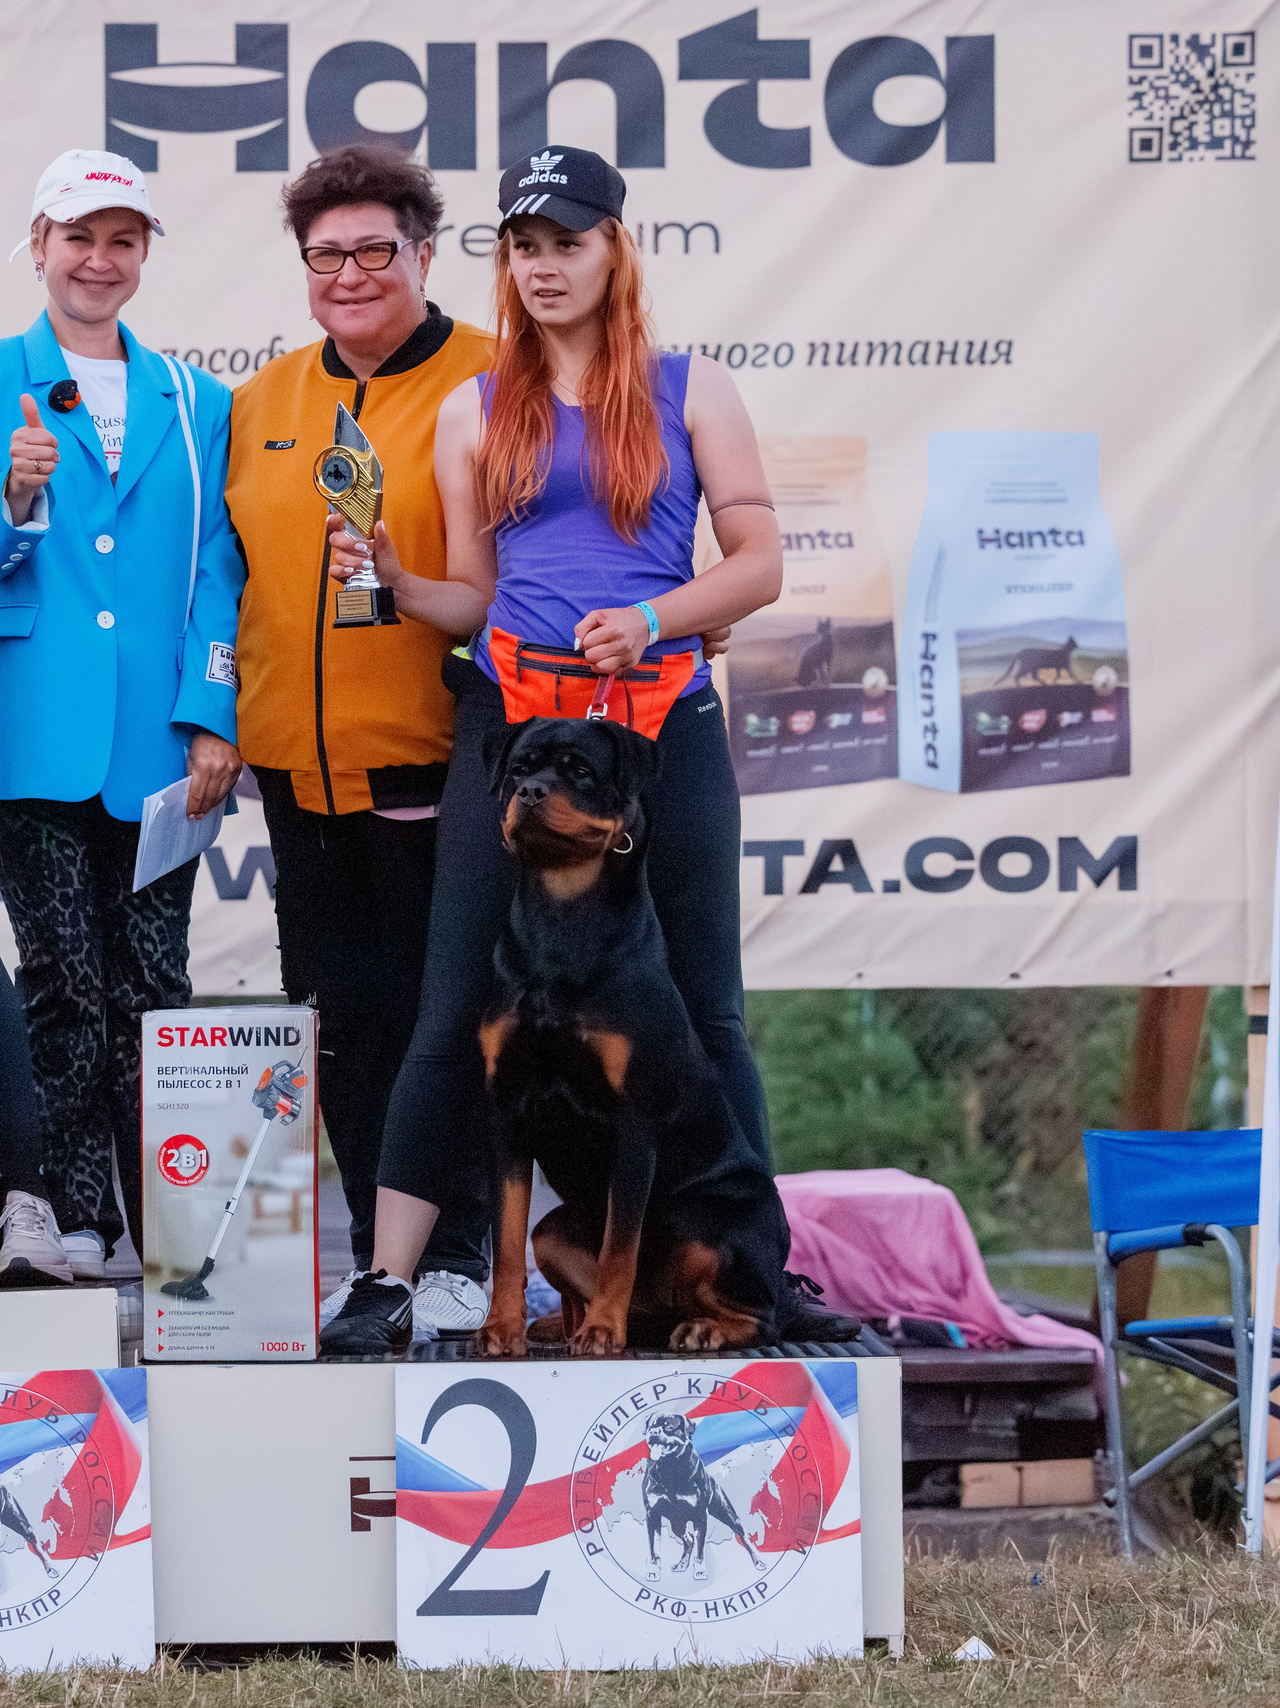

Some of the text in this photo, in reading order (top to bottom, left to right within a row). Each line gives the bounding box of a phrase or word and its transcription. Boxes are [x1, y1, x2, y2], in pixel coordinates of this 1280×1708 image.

[103, 7, 995, 174] Hanta
[519, 170, 568, 188] adidas
[807, 338, 1014, 367] питания
[780, 528, 854, 551] anta
[977, 527, 1086, 550] Hanta
[698, 701, 718, 714] Reebok
[919, 631, 940, 770] Hanta
[156, 1026, 301, 1047] STARWIND
[157, 1063, 249, 1076] ВЕРТИКАЛЬНЫЙ
[157, 1079, 242, 1089] ПЫЛЕСОС 2 В 1
[261, 1342, 306, 1352] 1000 Вт
[575, 1378, 819, 1557] РОТВЕЙЛЕР КЛУБ РОССИИ
[69, 1429, 110, 1562] РОССИИ
[416, 1377, 551, 1617] 2
[635, 1581, 770, 1619] РКФ-НКПР
